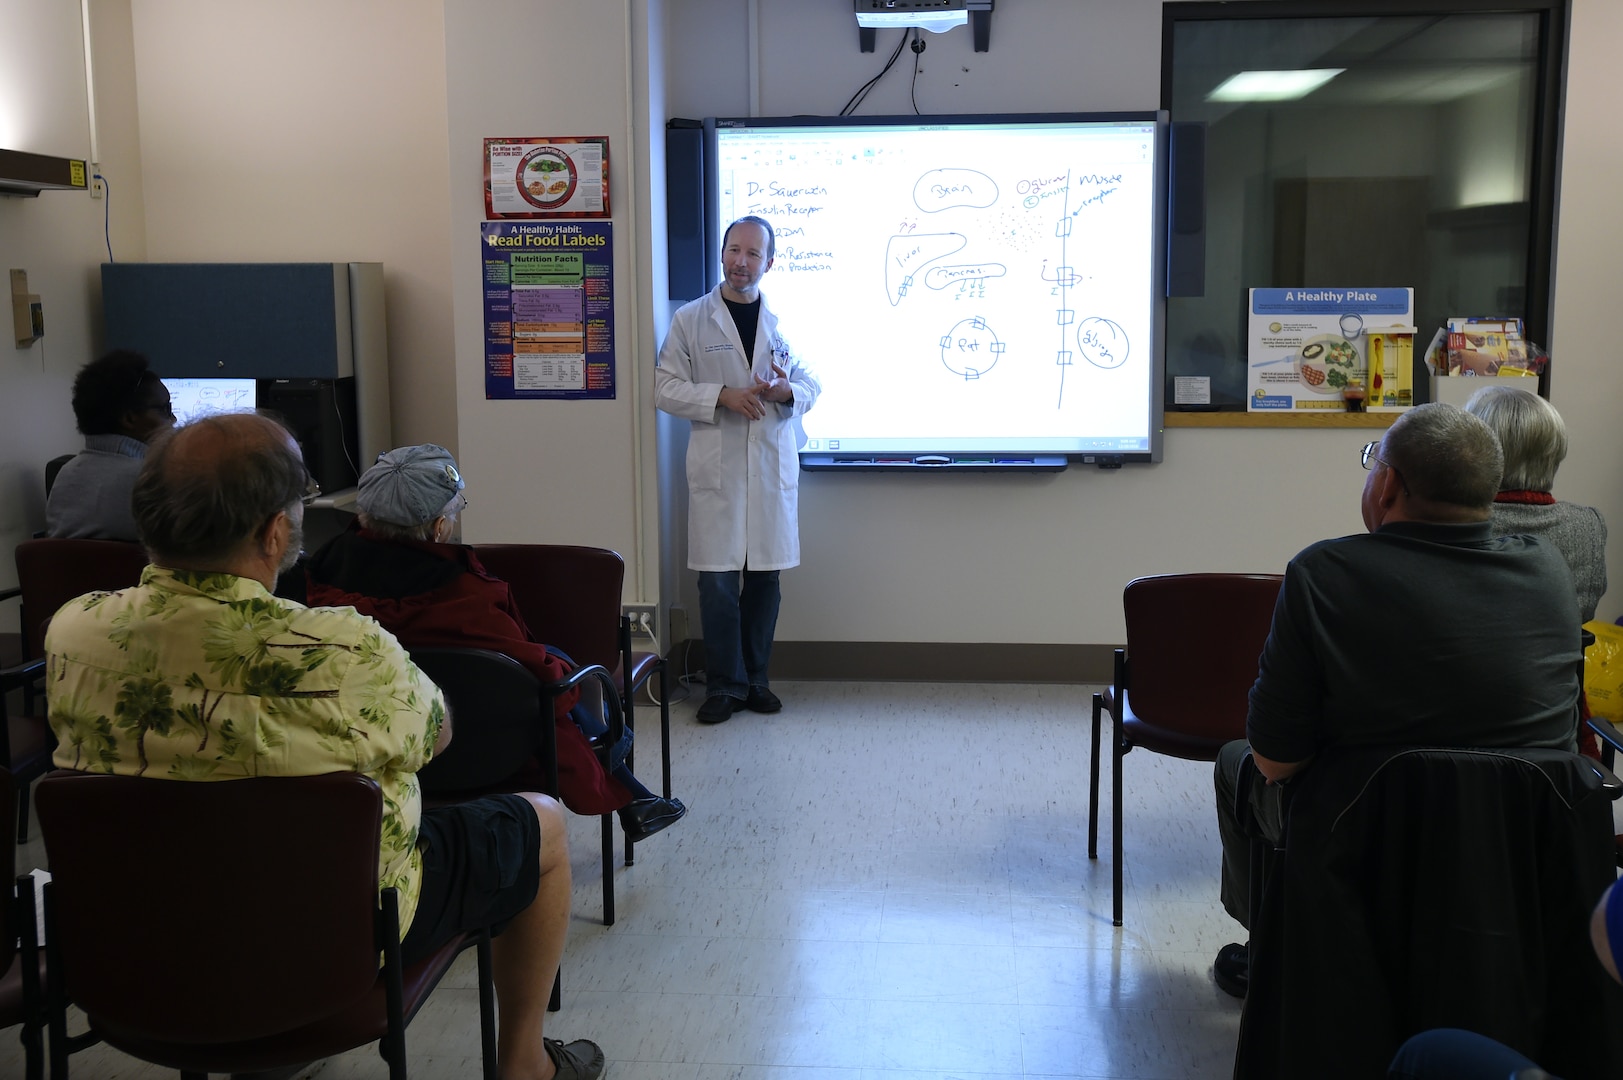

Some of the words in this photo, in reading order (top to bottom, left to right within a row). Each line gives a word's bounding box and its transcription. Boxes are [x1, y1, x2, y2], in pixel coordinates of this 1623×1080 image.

[746, 181, 765, 197] Dr
[511, 226, 518, 234] A
[519, 225, 554, 236] Healthy
[556, 225, 582, 234] Habit:
[488, 235, 522, 247] Read
[526, 234, 560, 247] Food
[563, 234, 606, 247] Labels
[515, 255, 552, 263] Nutrition
[555, 255, 579, 263] Facts
[1285, 292, 1294, 301] A
[1298, 291, 1343, 303] Healthy
[1347, 291, 1377, 301] Plate
